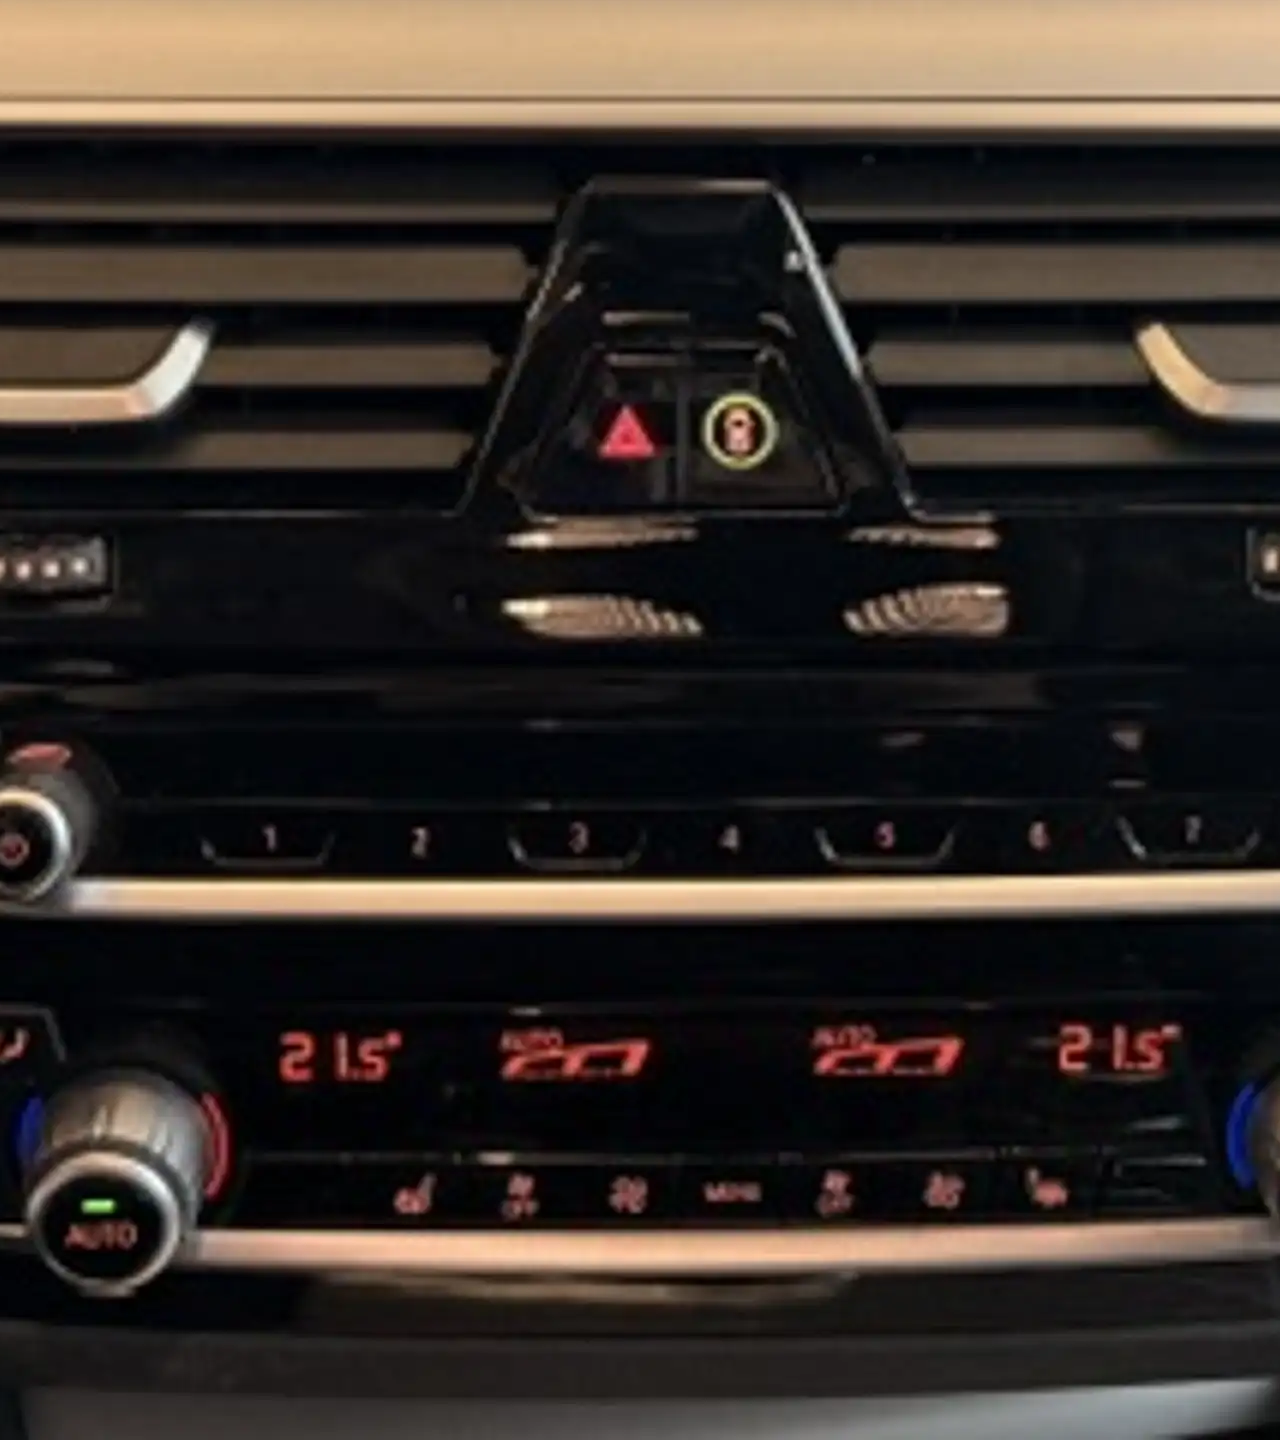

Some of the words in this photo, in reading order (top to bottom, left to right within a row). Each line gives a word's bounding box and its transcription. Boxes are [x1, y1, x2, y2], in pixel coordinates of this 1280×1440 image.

[260, 825, 280, 853] 1
[568, 822, 590, 852] 3
[718, 824, 740, 851] 4
[64, 1223, 139, 1250] AUTO
